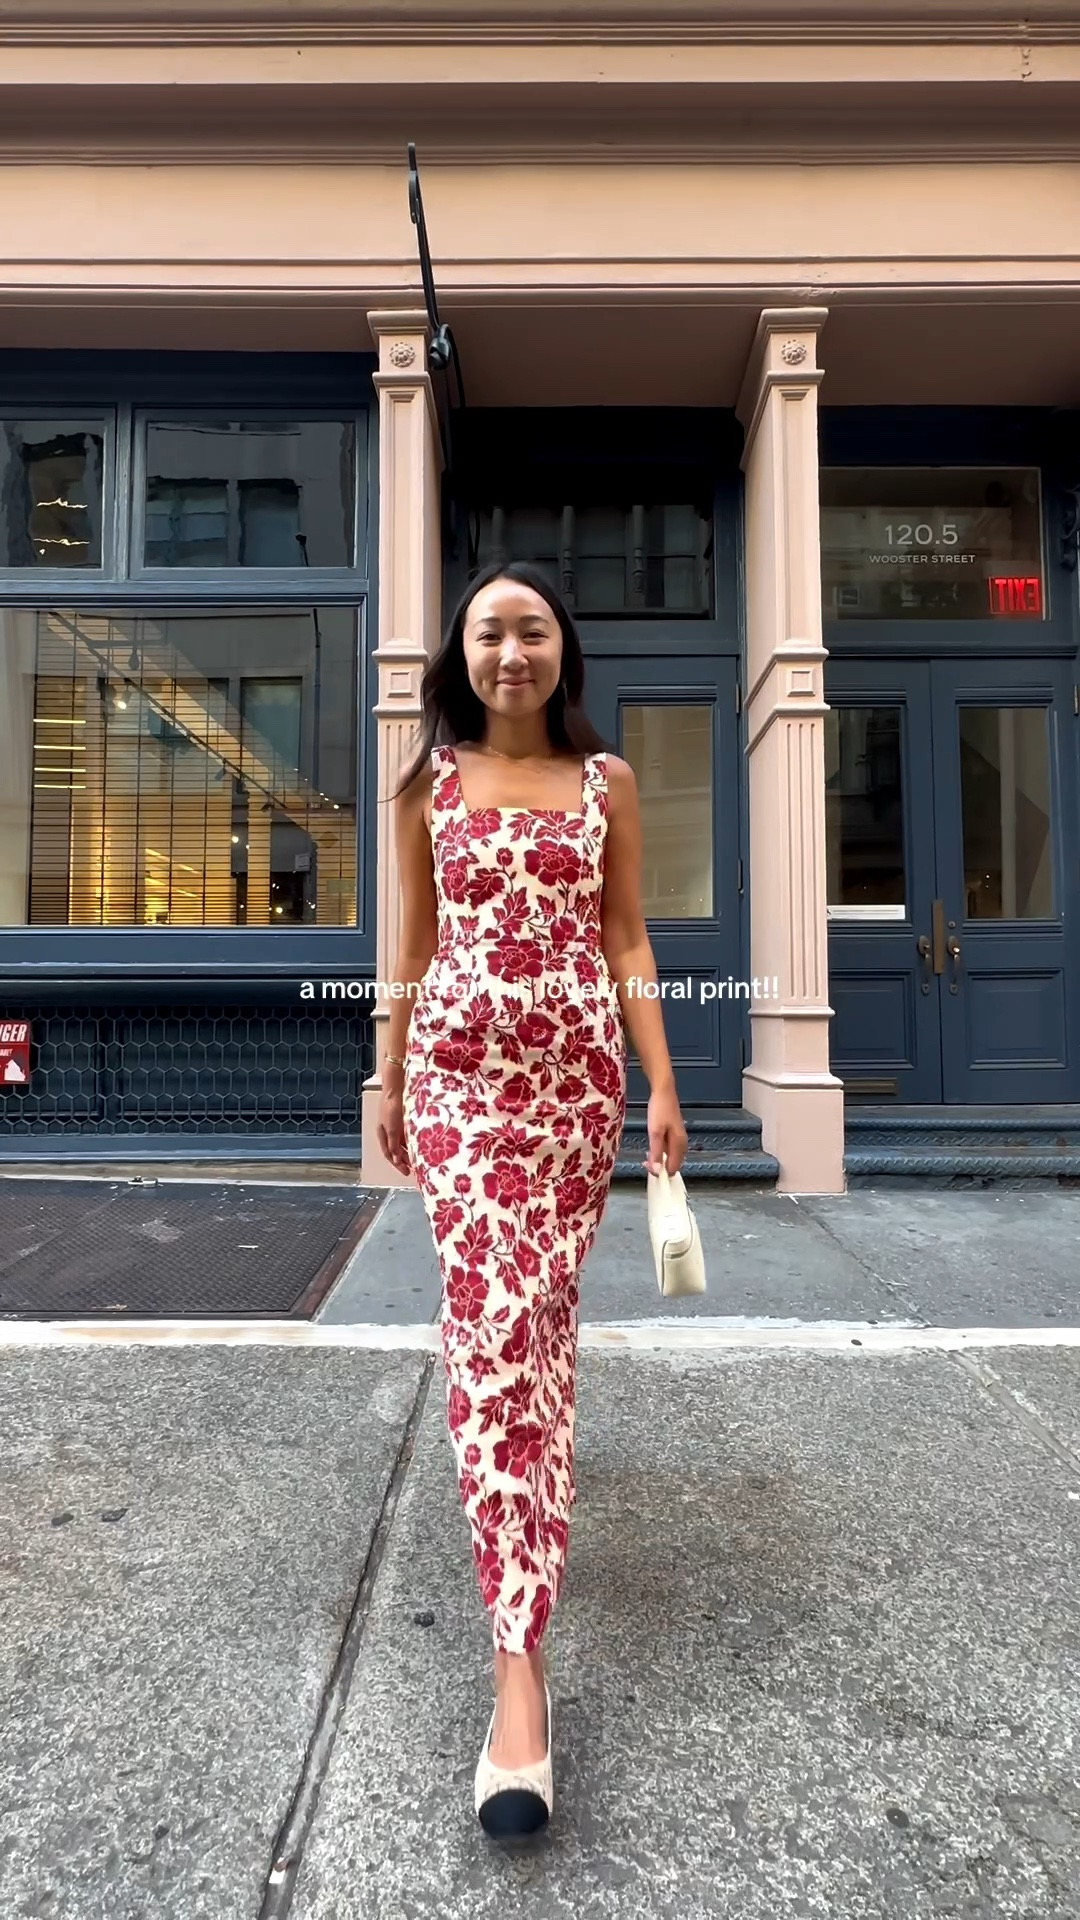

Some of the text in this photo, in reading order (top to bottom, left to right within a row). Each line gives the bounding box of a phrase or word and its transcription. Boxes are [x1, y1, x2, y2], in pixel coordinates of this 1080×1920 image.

[885, 524, 958, 545] 120.5
[869, 555, 975, 564] WOOSTER STREET
